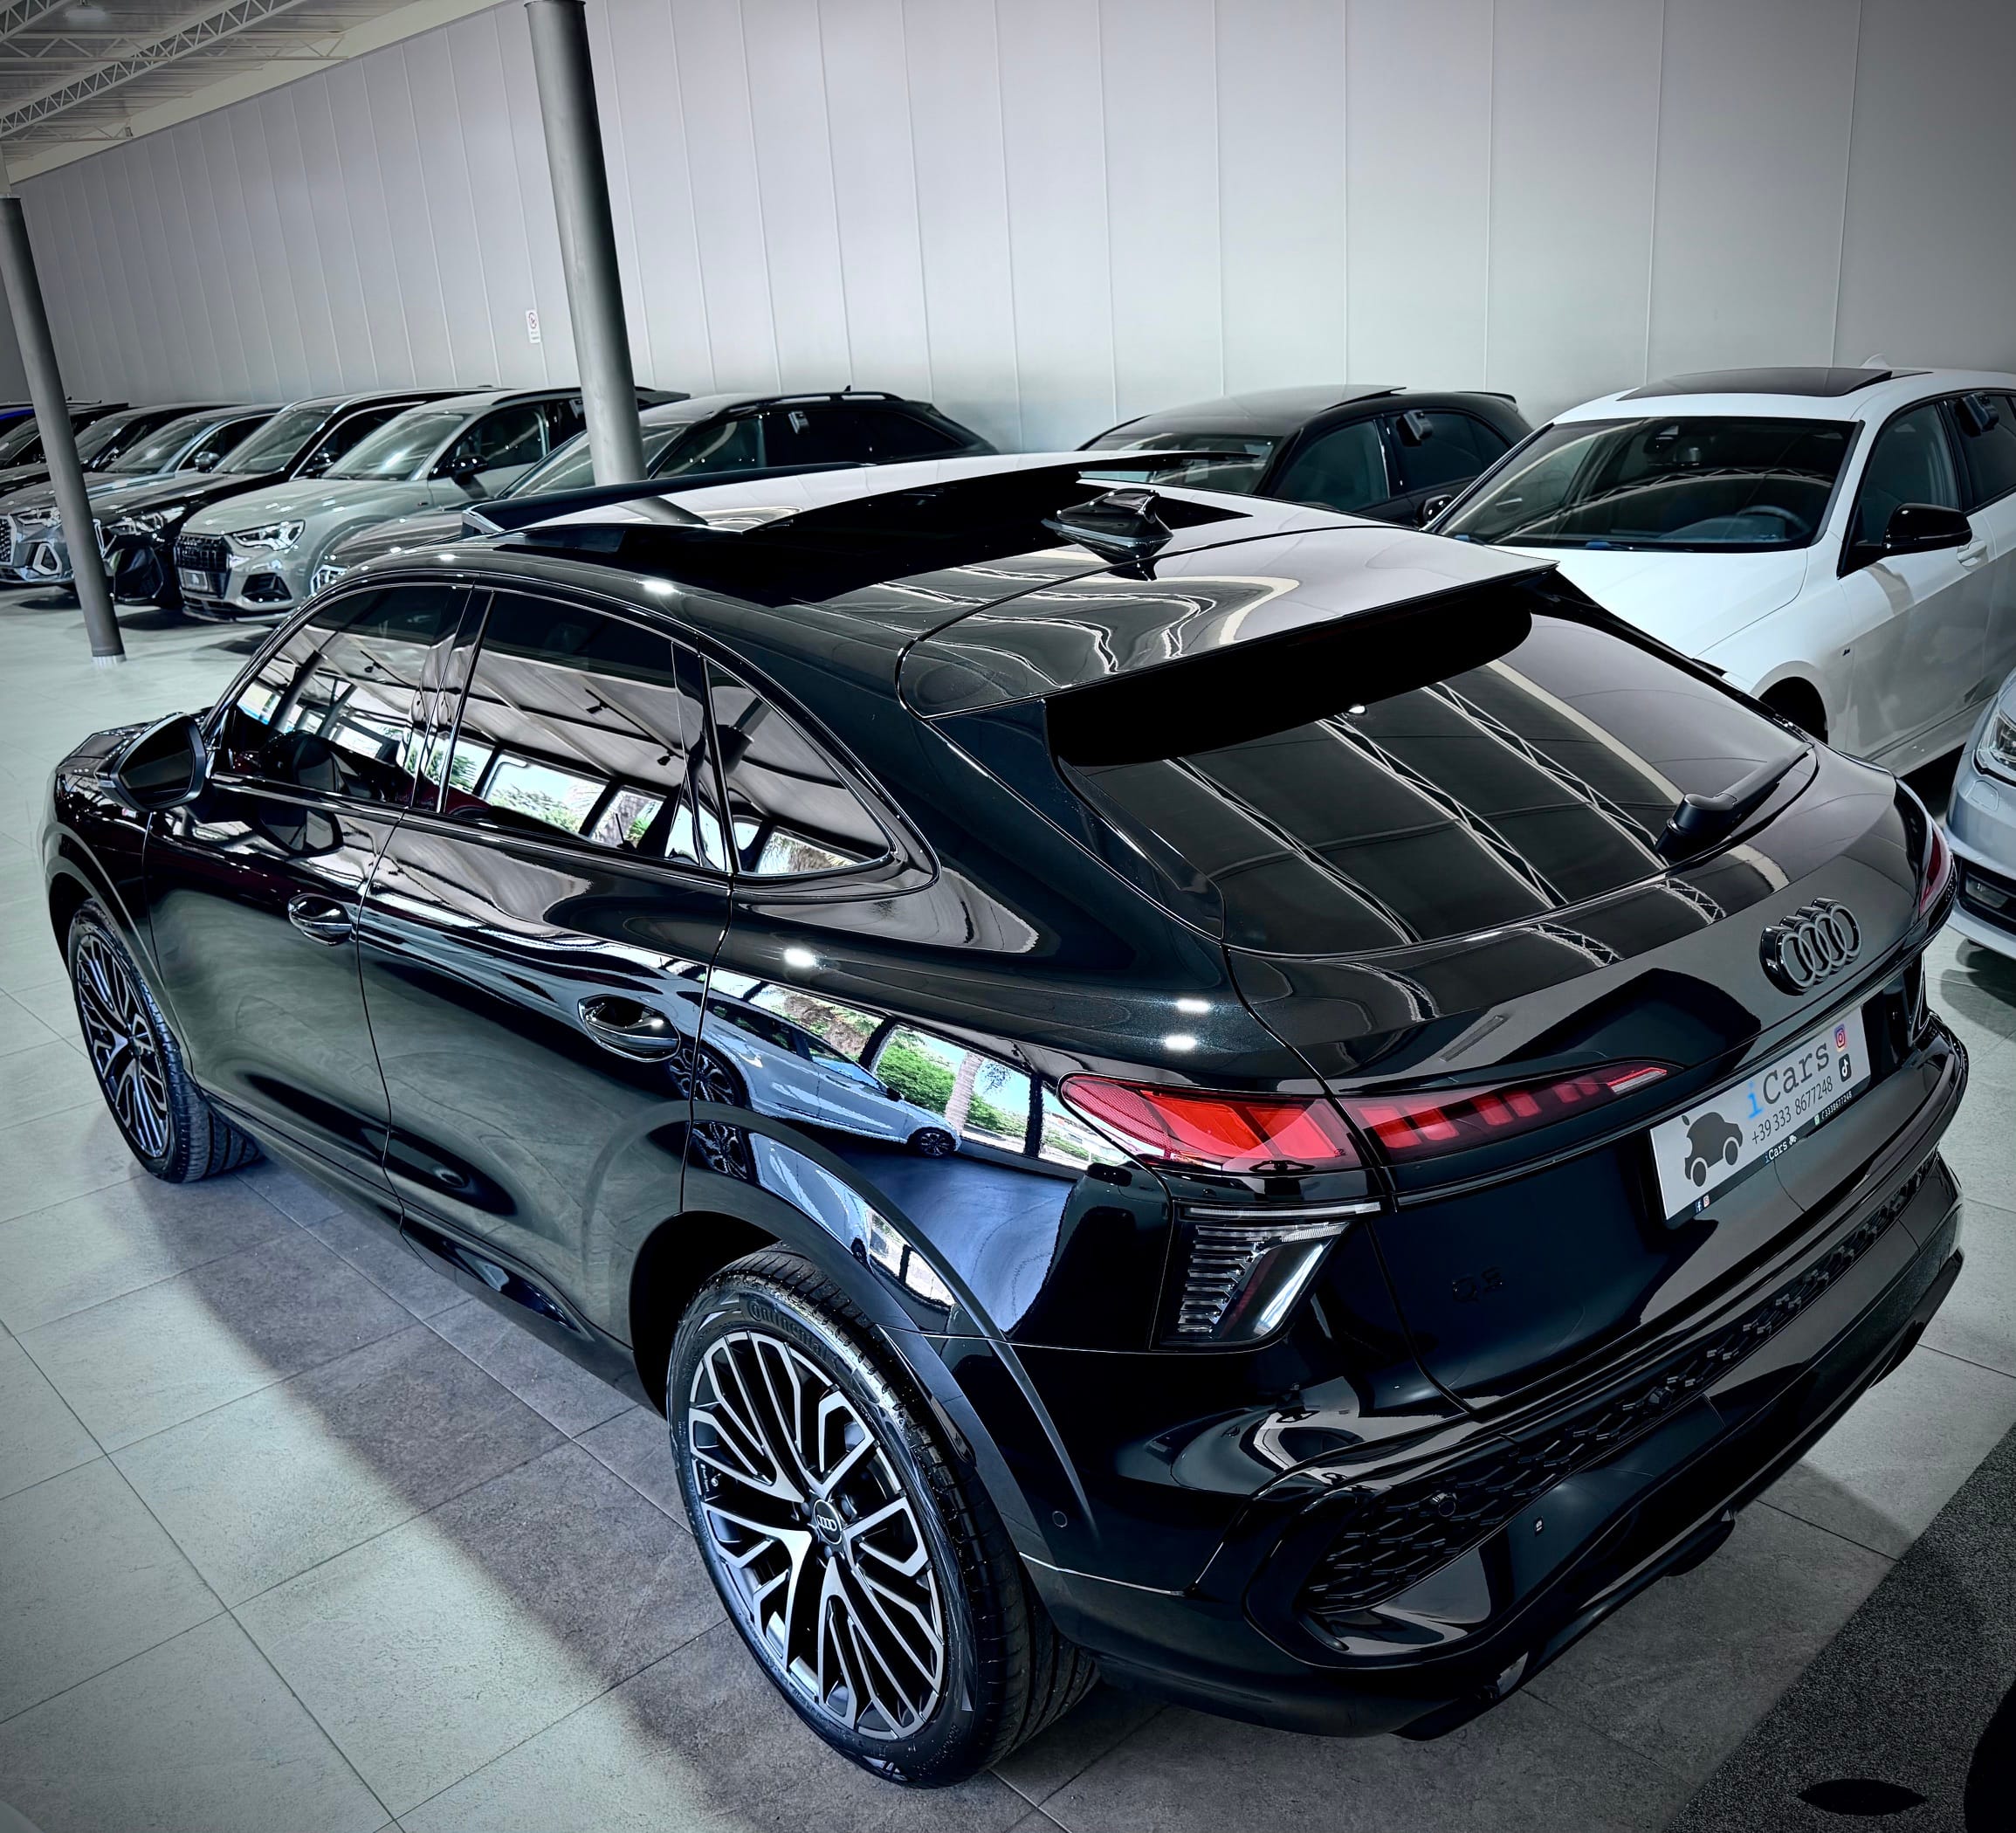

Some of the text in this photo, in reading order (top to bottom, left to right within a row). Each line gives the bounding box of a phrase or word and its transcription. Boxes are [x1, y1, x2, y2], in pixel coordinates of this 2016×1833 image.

[1748, 1043, 1829, 1119] iCars
[1751, 1075, 1833, 1145] +39 333 8677248
[1765, 1141, 1788, 1163] iCars
